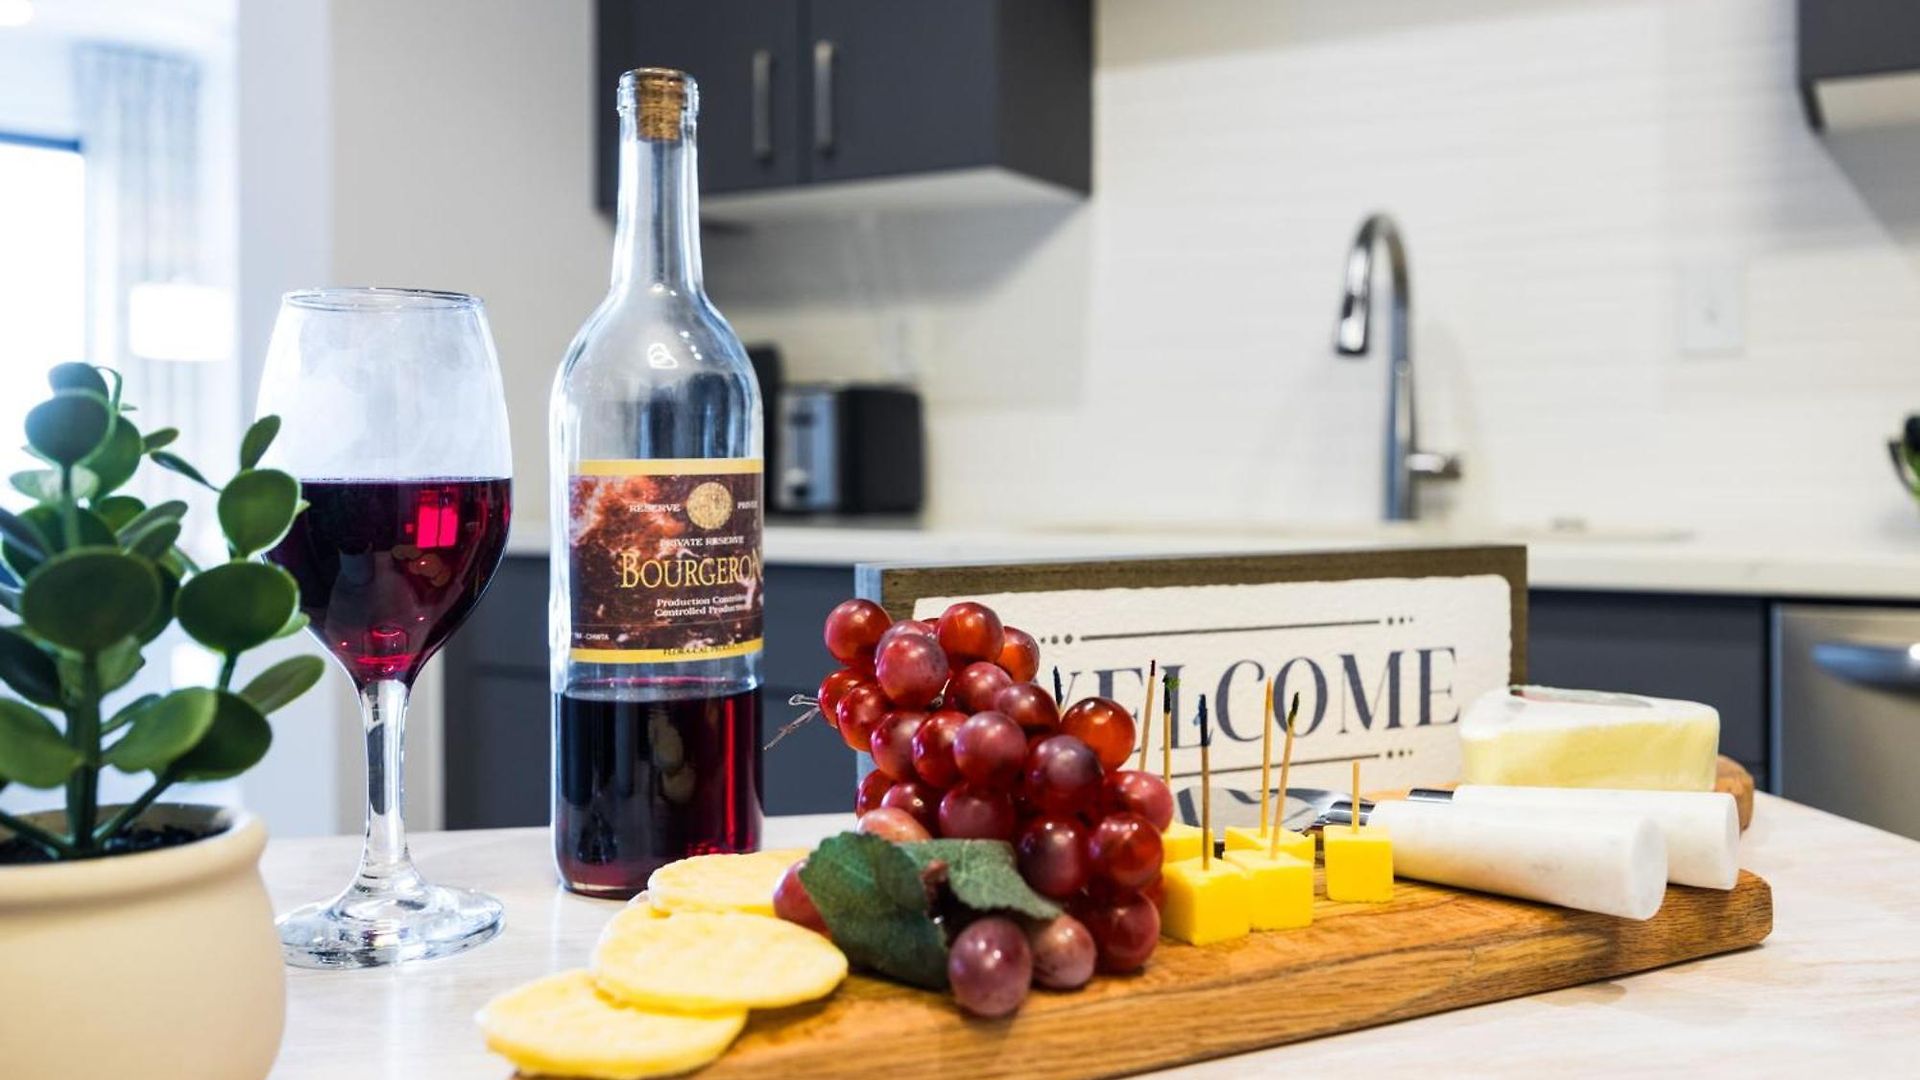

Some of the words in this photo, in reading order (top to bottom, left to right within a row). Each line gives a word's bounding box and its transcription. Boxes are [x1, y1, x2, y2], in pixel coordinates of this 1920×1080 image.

[659, 537, 703, 547] PRIVATE
[705, 536, 745, 546] RESERVE
[656, 597, 710, 608] Production
[654, 606, 706, 617] Controlled
[1034, 646, 1460, 755] ELCOME
